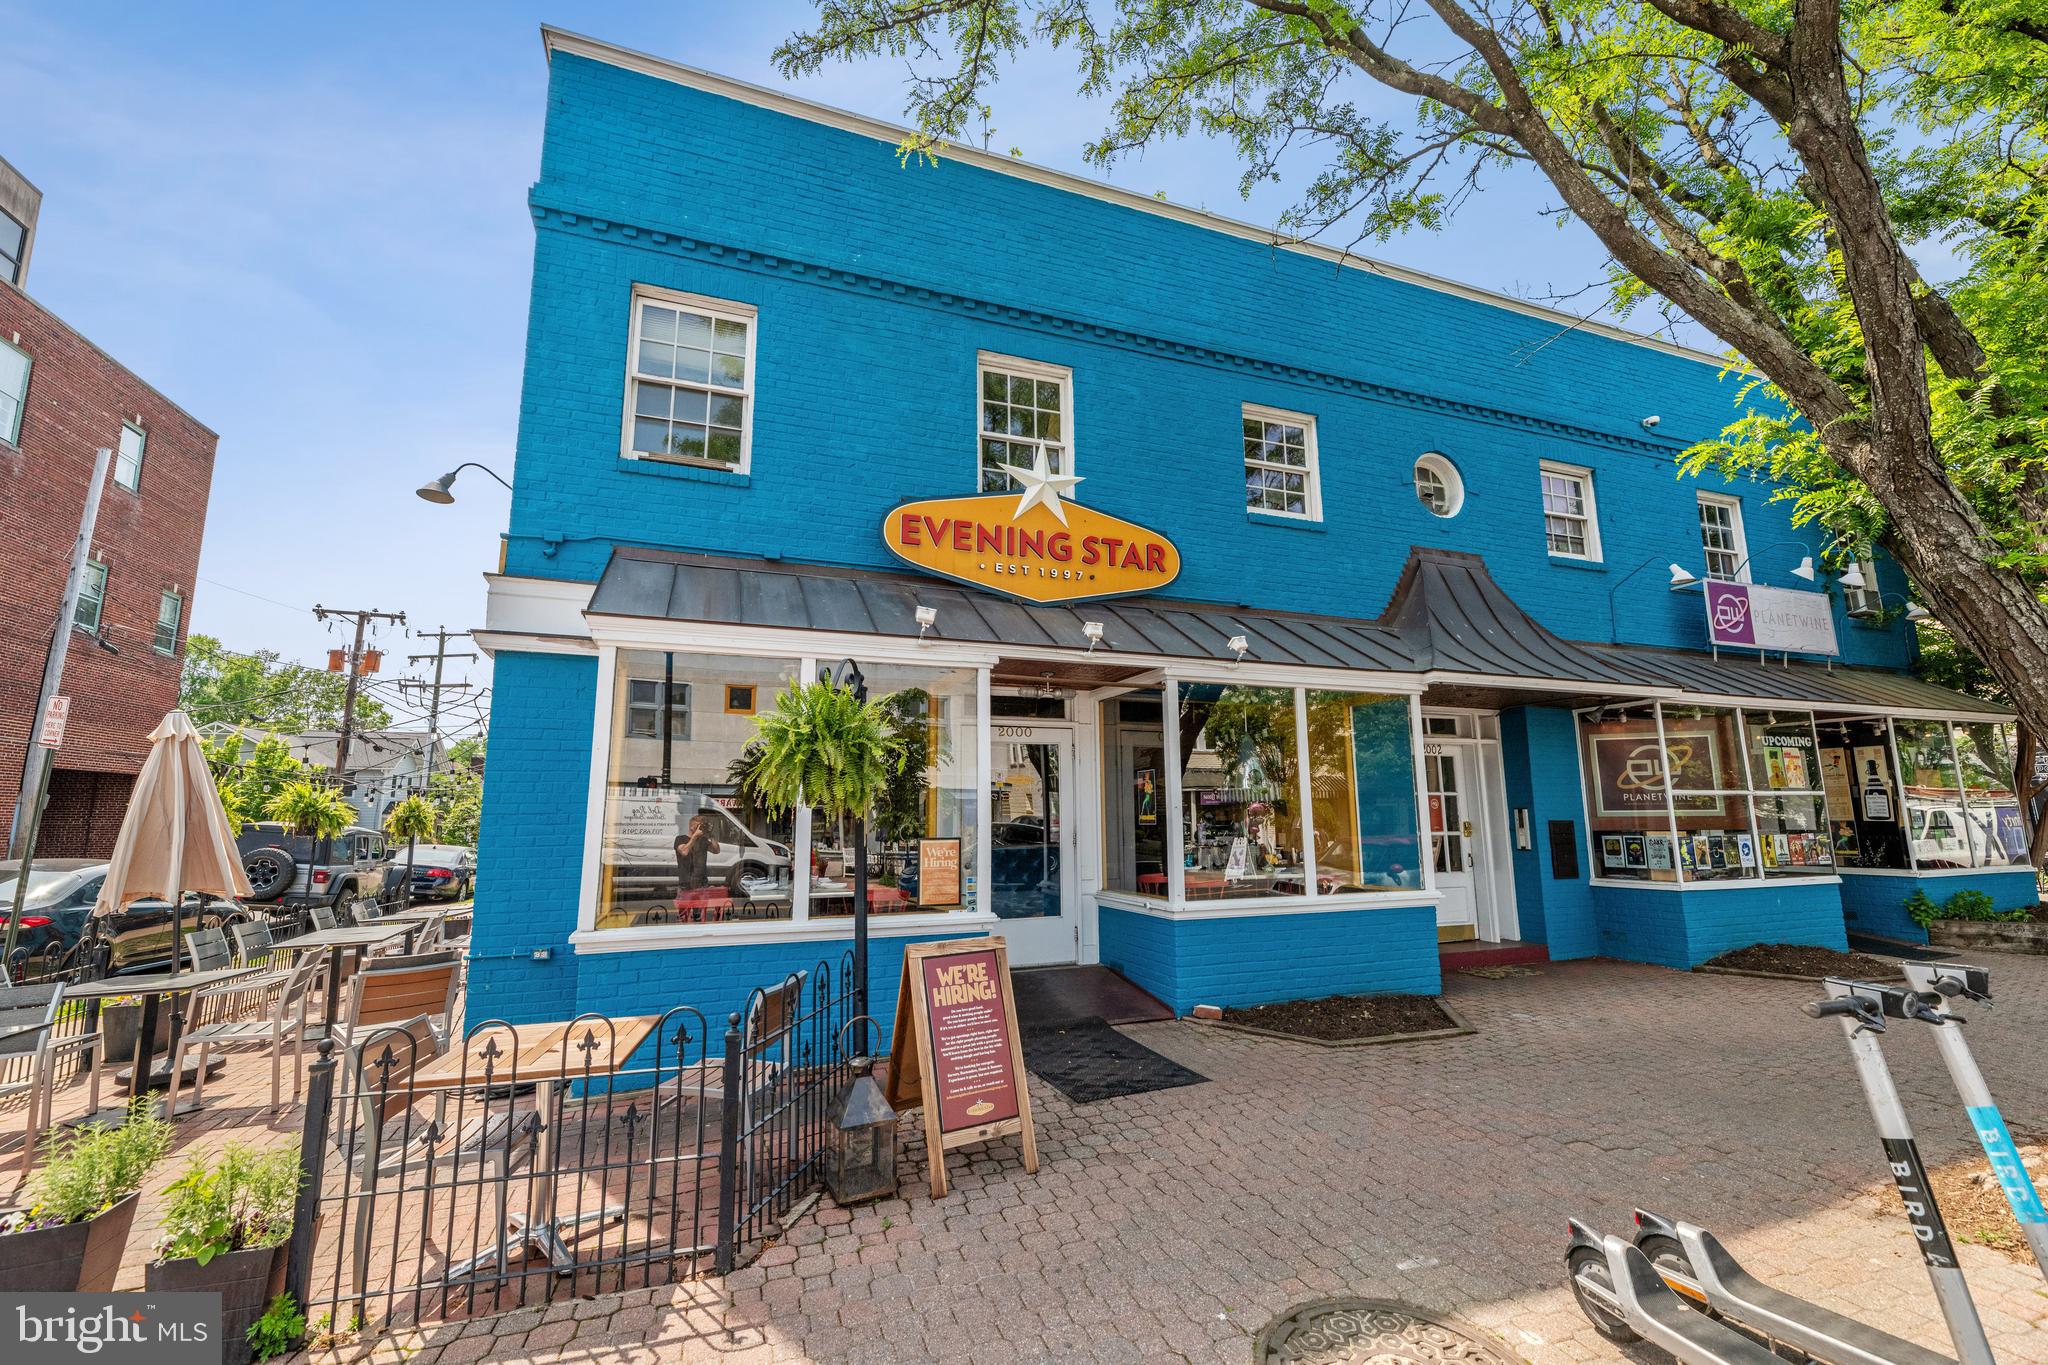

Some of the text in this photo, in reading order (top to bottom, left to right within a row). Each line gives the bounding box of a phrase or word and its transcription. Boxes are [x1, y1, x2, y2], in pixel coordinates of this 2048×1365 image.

[901, 513, 1167, 573] EVENING STAR
[995, 562, 1084, 581] EST 1997
[1753, 610, 1830, 631] PLANETWINE
[53, 700, 63, 711] NO
[998, 727, 1032, 738] 2000
[1761, 735, 1813, 747] UPCOMING
[926, 847, 957, 857] We're
[924, 857, 958, 871] Hiring
[935, 962, 989, 987] WE'RE
[932, 983, 997, 1007] HIRING!
[1889, 1160, 1934, 1242] BIRD
